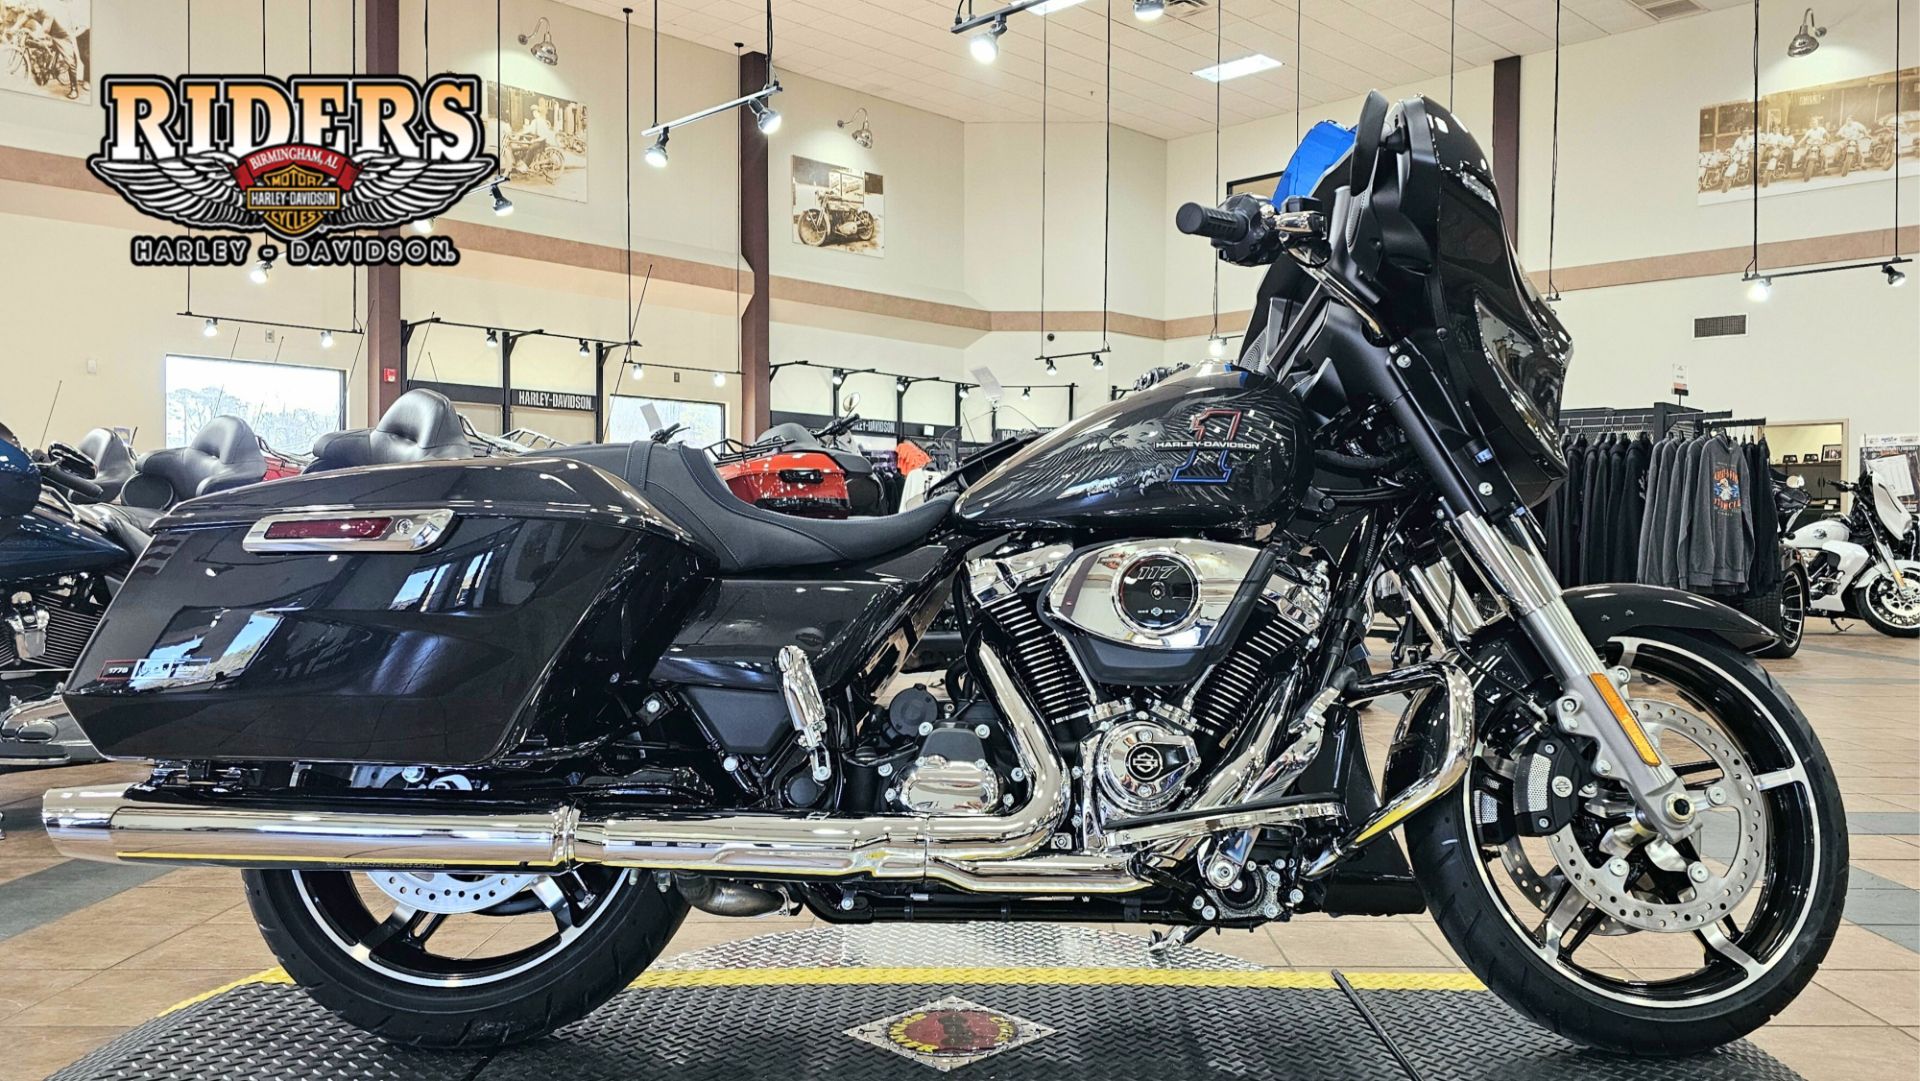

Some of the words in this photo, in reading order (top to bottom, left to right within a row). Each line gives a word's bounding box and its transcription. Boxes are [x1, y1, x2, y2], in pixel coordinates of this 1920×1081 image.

[518, 390, 593, 410] HARLEY-DAVIDSON
[1155, 440, 1260, 450] HARLEY-DAVIDSON
[1137, 565, 1179, 580] 117
